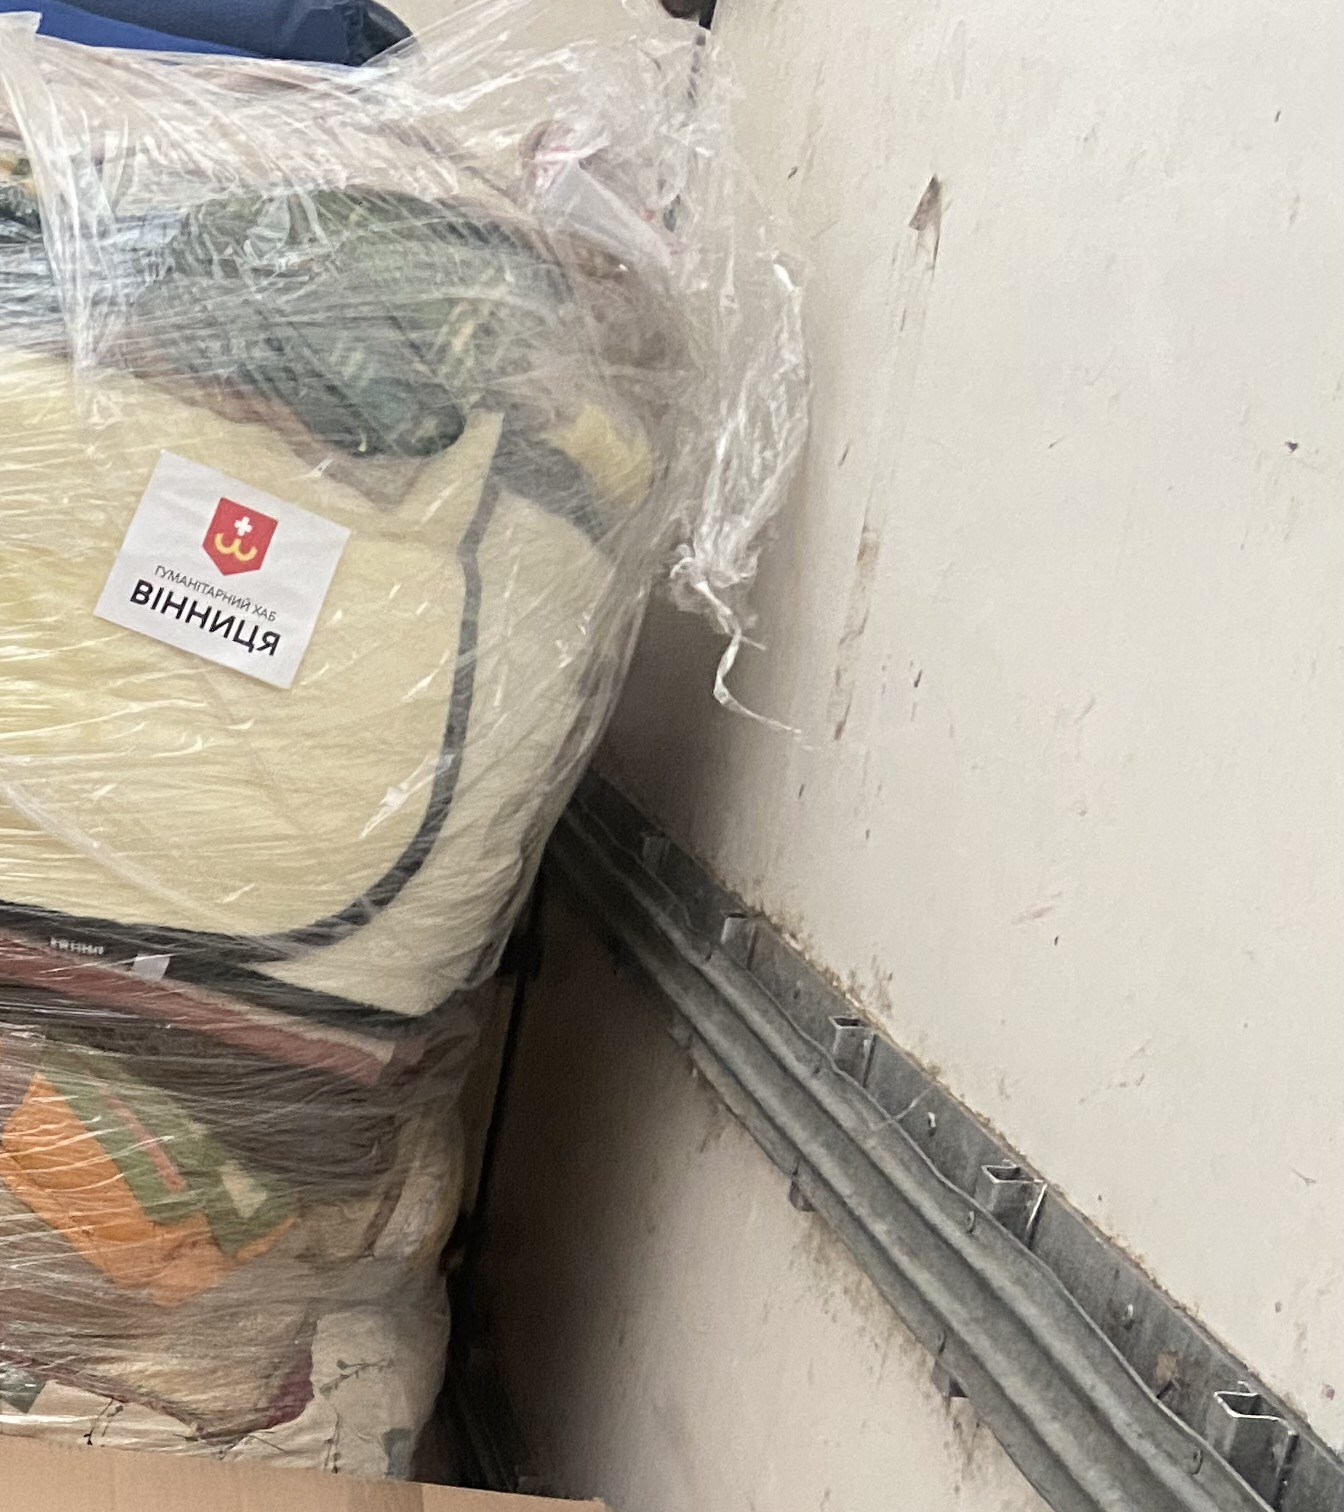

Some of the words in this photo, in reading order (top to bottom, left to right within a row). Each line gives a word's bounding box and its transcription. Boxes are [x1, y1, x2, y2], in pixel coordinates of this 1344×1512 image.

[129, 579, 282, 657] ВІННИЦЯ
[153, 564, 250, 611] ГУМАНІТАРНИЙ
[251, 604, 278, 622] ХАБ
